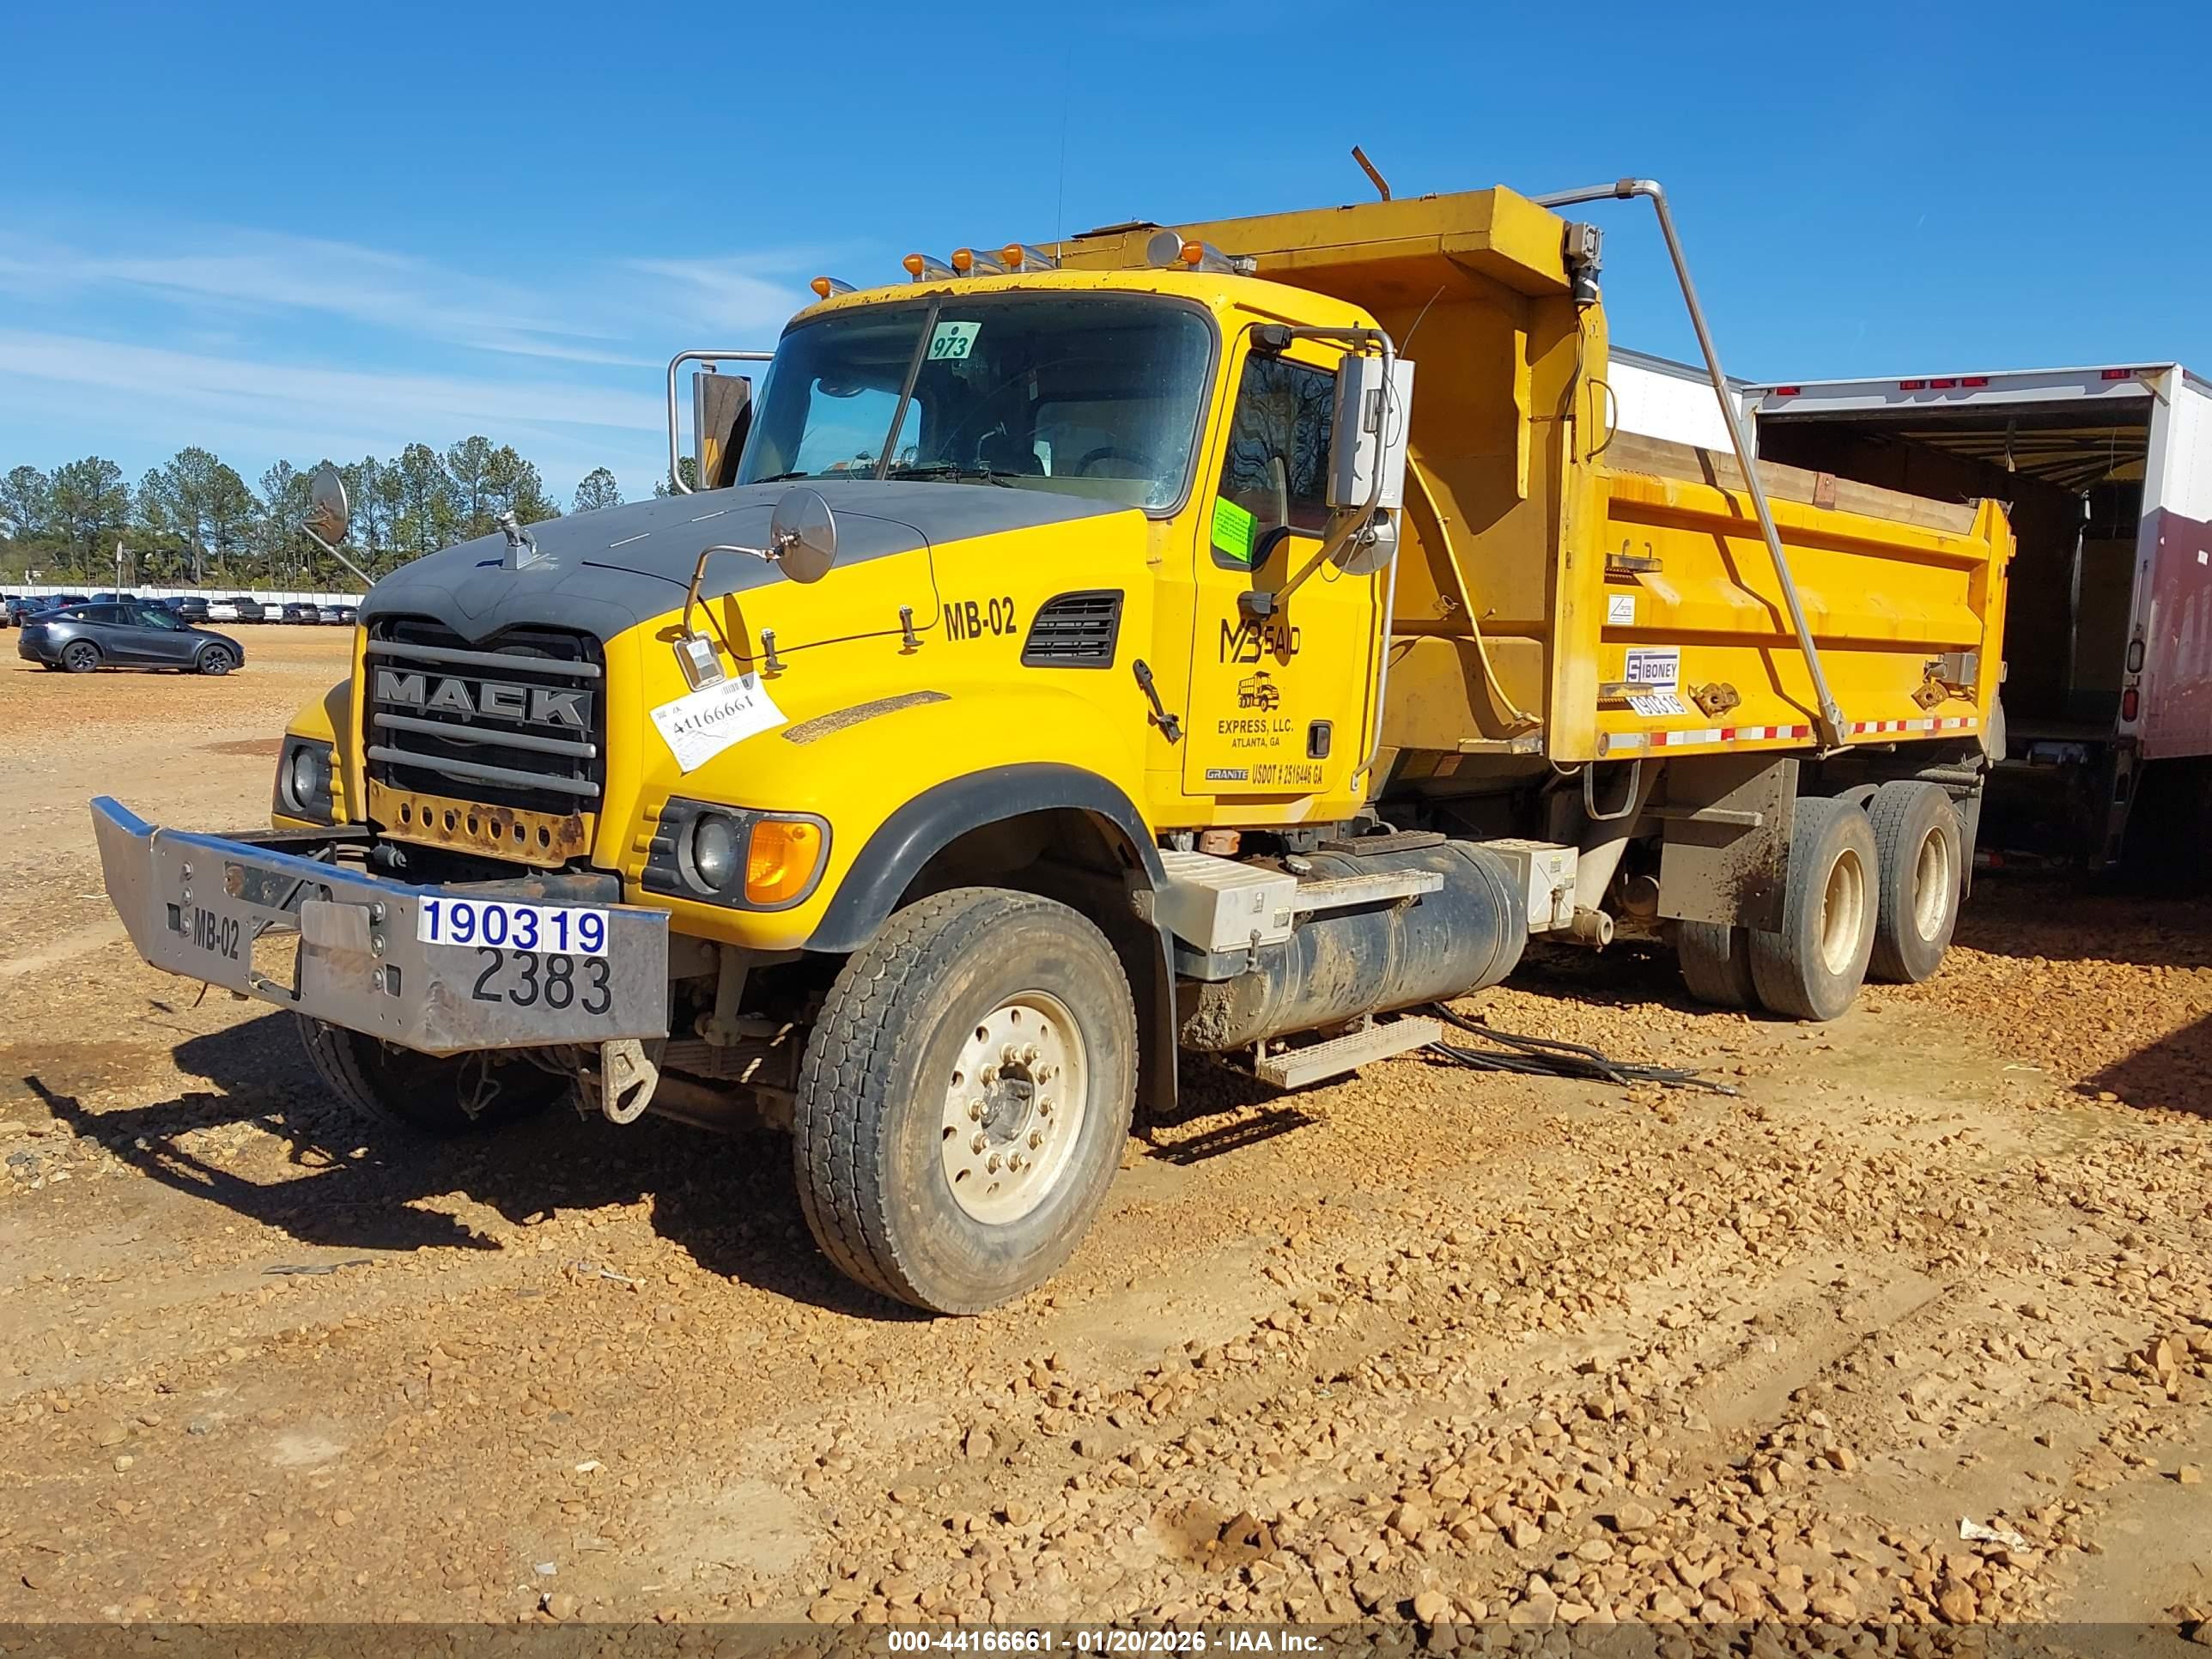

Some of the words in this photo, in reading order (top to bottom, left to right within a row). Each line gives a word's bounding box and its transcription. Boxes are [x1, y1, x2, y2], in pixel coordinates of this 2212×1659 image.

[934, 337, 969, 357] 973
[943, 596, 1018, 641] MB-02
[377, 670, 585, 726] MACK
[1630, 695, 1686, 715] 190319
[1218, 720, 1270, 735] EXPRESS,
[1273, 719, 1294, 732] LLC.
[1231, 738, 1268, 749] ATLANTA,
[1270, 737, 1280, 746] GA
[1252, 763, 1277, 784] USDOT
[1313, 764, 1322, 785] GA
[193, 907, 240, 960] MB-02
[423, 901, 605, 953] 190319
[471, 945, 612, 1016] 2383
